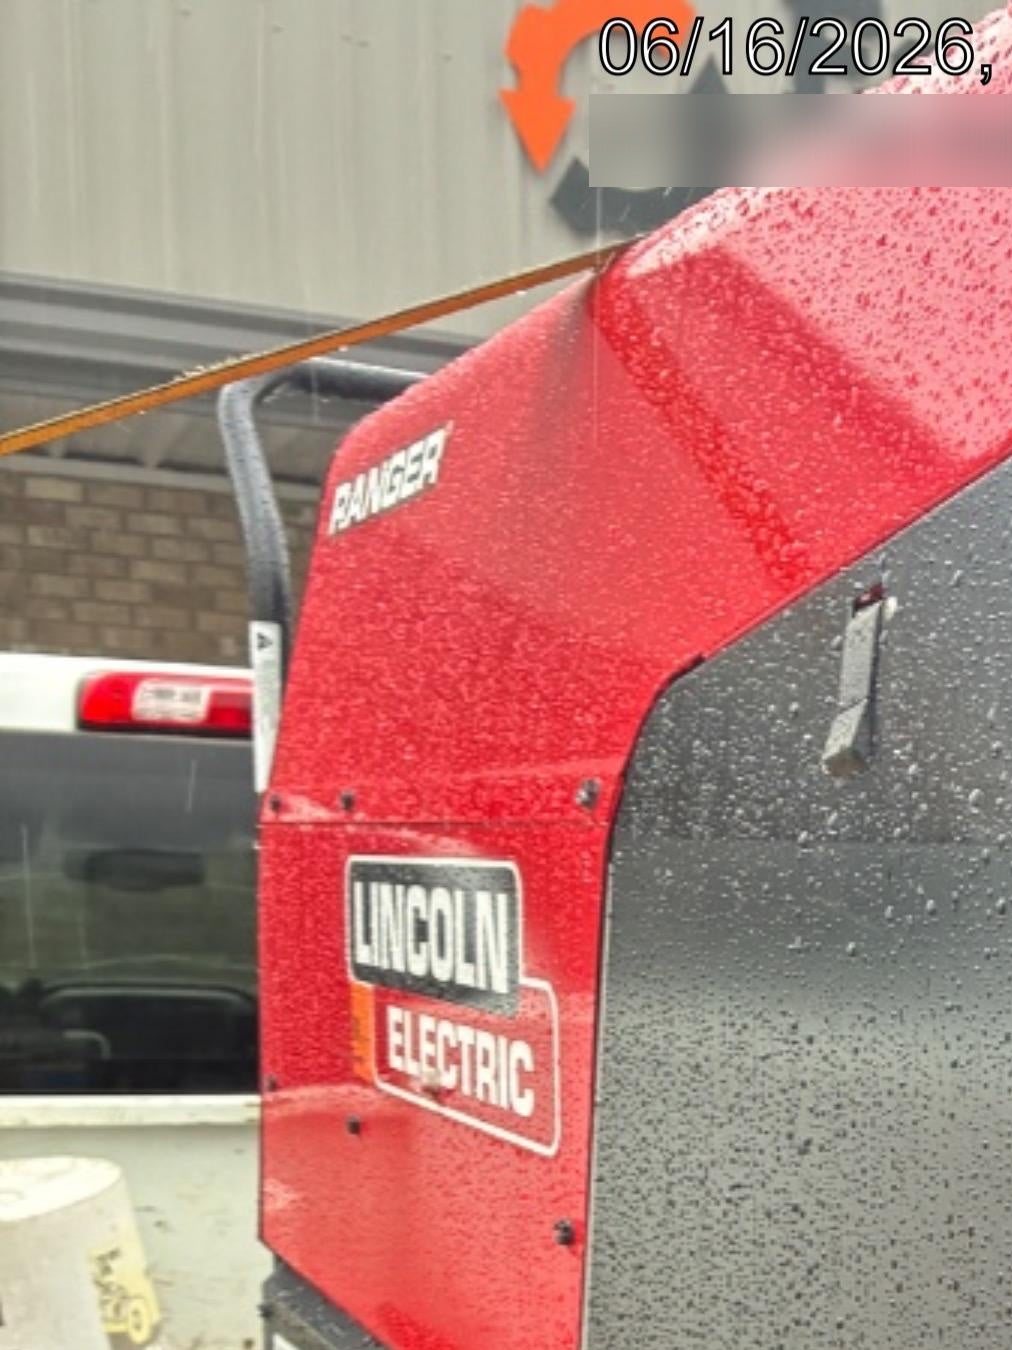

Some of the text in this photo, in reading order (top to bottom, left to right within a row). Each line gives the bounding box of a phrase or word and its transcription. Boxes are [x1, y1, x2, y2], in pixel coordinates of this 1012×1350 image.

[328, 428, 446, 535] RANGER
[353, 880, 509, 994] LINCOLN
[386, 1004, 535, 1118] ELECTRIC
